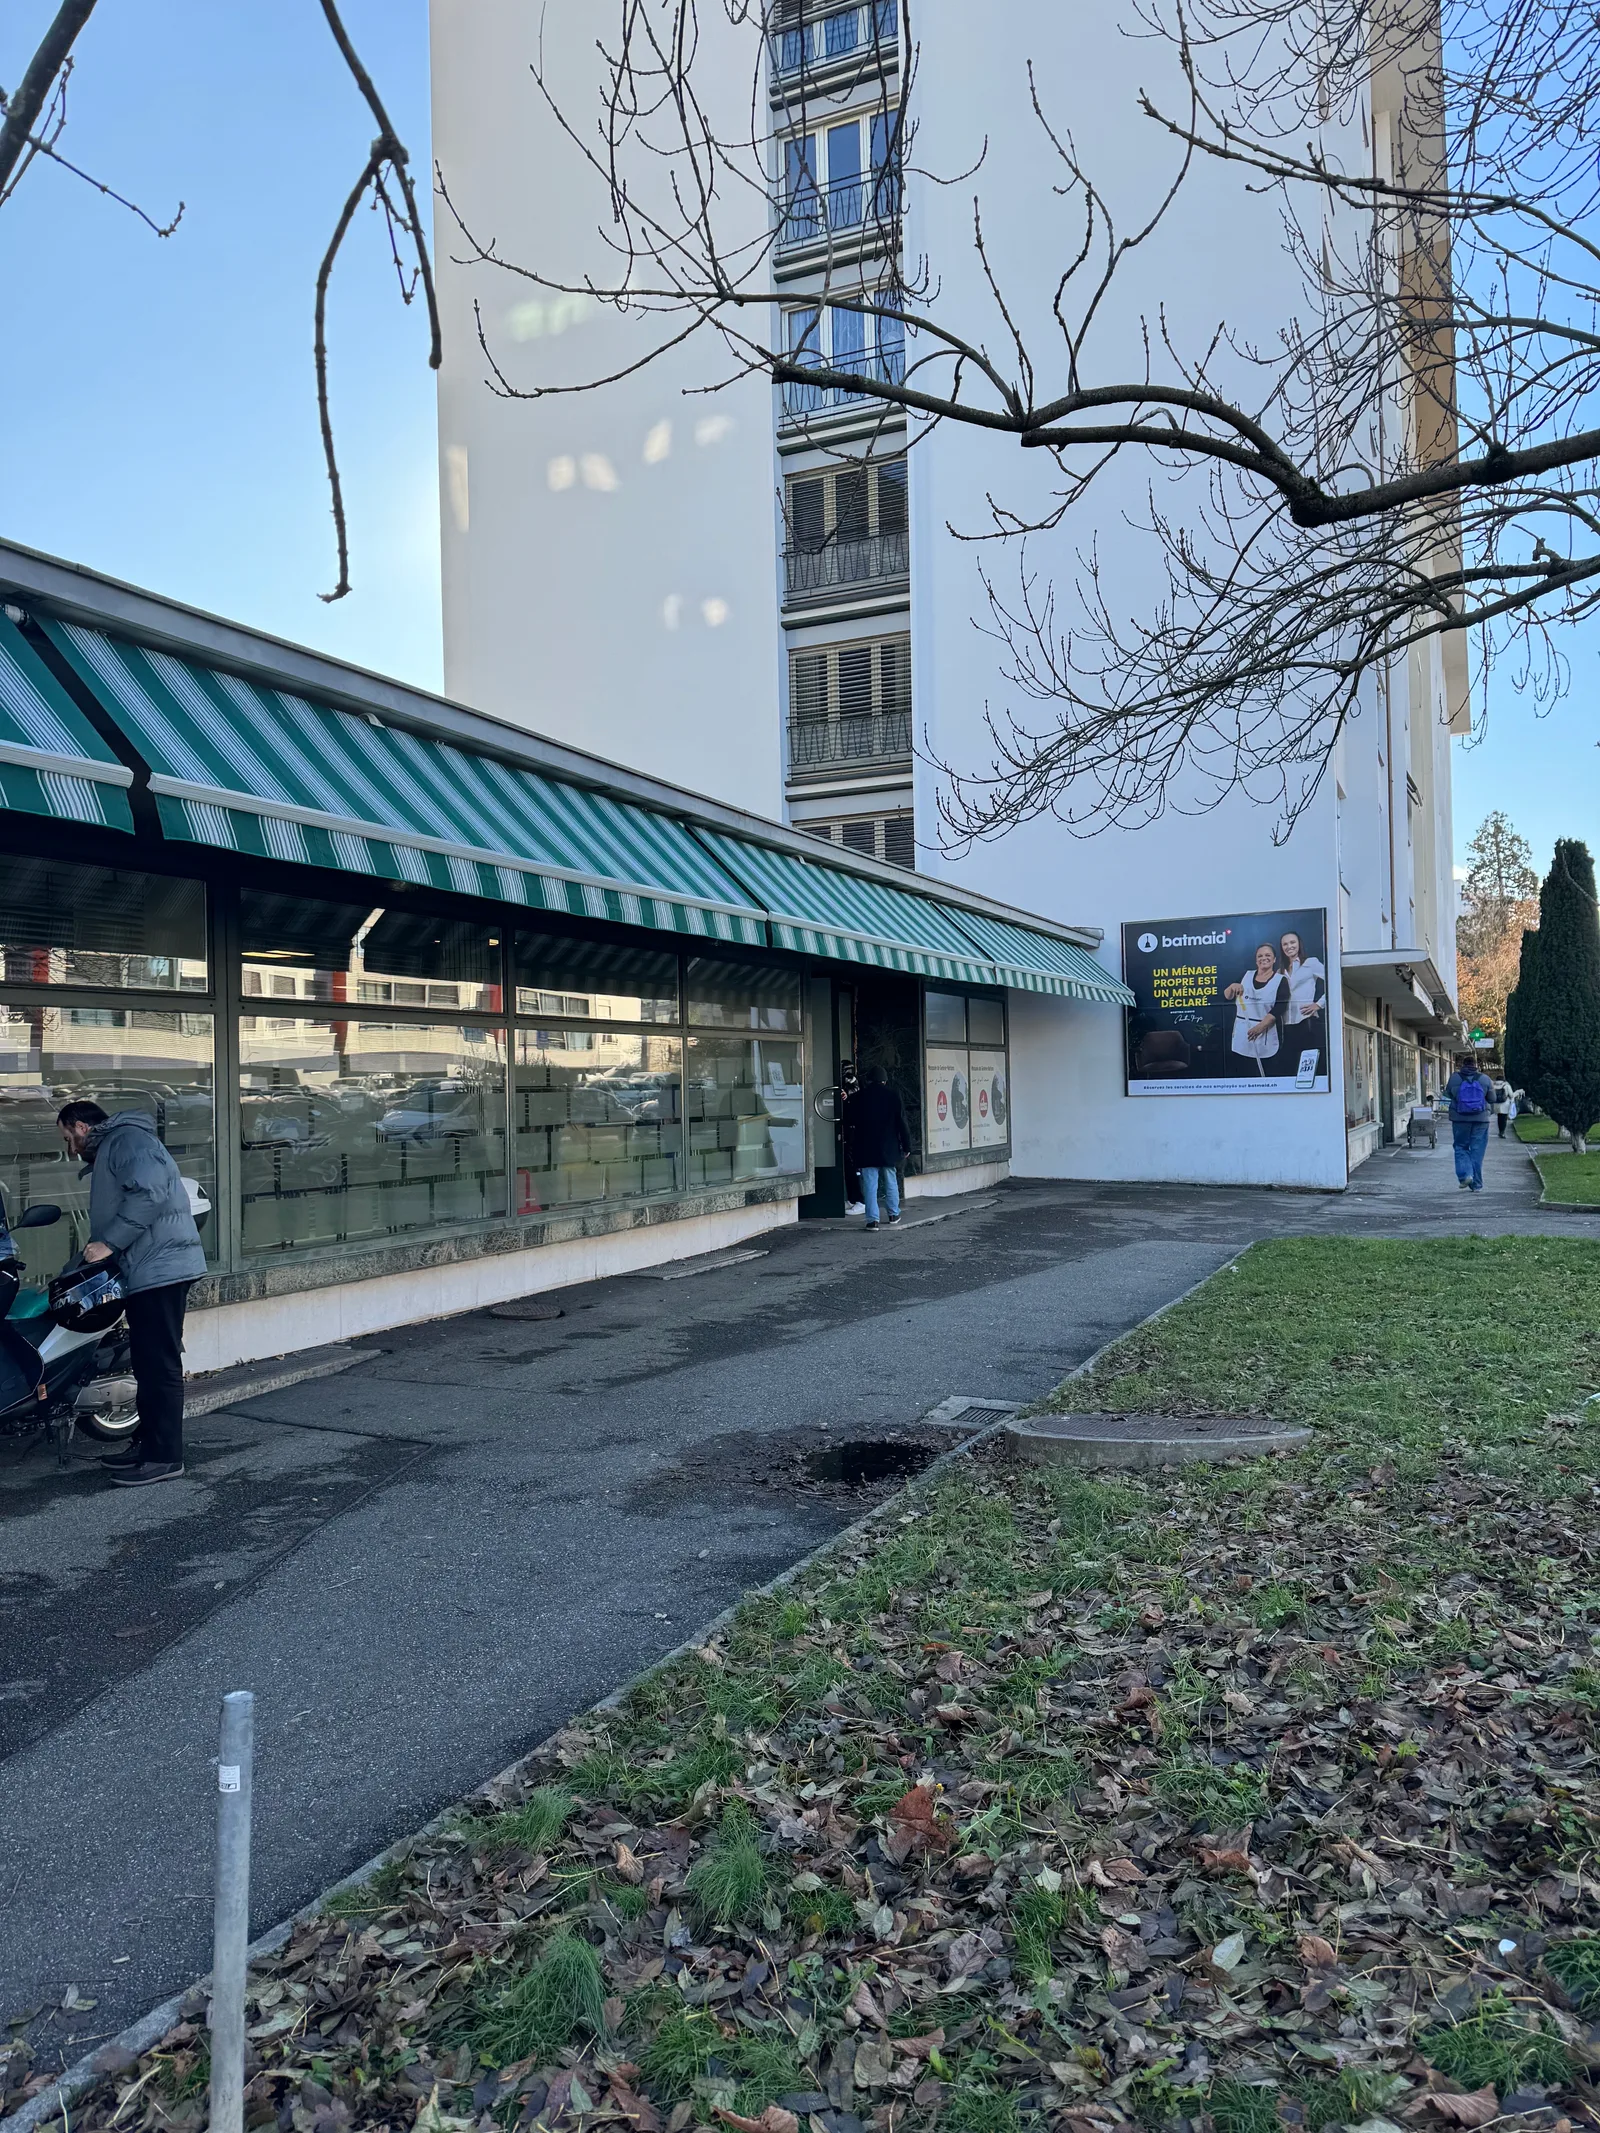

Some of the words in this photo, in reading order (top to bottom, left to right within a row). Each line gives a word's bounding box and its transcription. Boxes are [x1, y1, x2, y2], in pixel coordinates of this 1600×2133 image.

[1162, 931, 1226, 947] batmaid
[1153, 968, 1169, 977] UN
[1171, 965, 1217, 976] MÉNAGE
[1153, 977, 1195, 987] PROPRE
[1198, 976, 1217, 985] EST
[1153, 990, 1169, 998] UN
[1172, 986, 1218, 997] MÉNAGE
[1161, 995, 1211, 1008] DÉCLARÉ.
